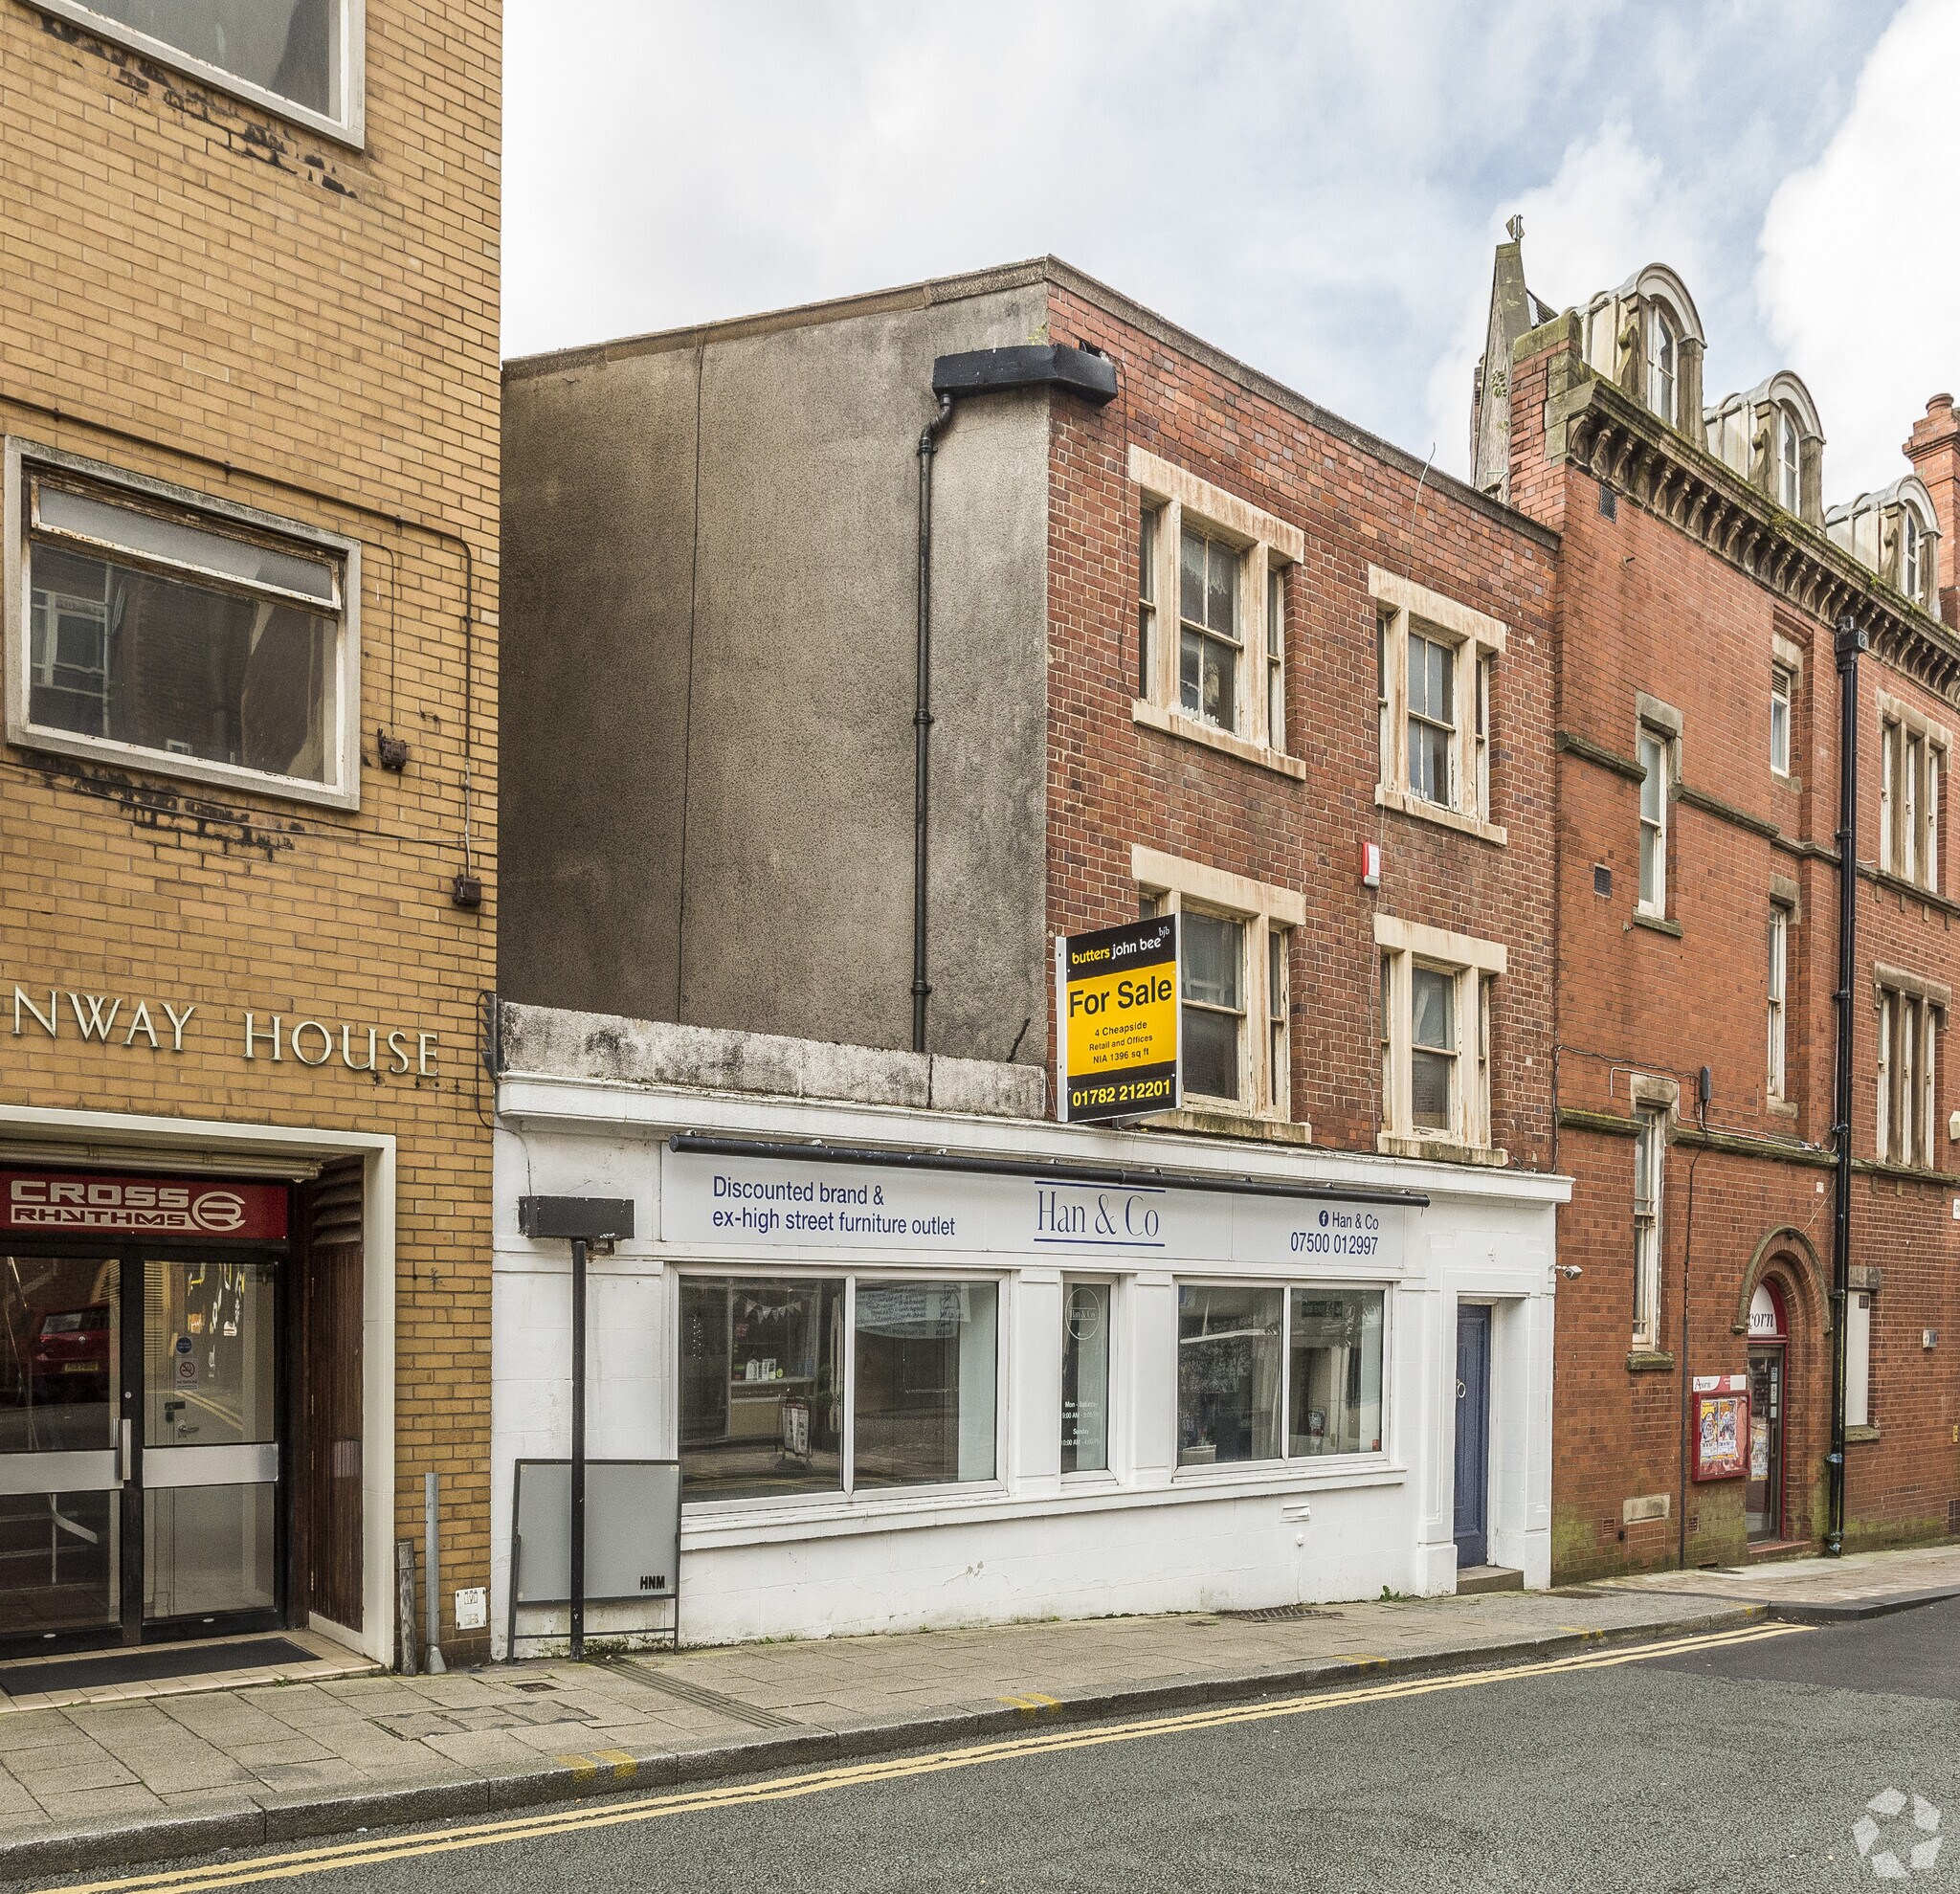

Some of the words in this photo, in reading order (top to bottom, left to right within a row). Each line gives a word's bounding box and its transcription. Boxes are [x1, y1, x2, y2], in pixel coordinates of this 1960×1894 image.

[1072, 948, 1110, 965] butters
[1112, 941, 1137, 960] john
[1140, 937, 1161, 951] bee
[1070, 989, 1109, 1018] For
[1118, 975, 1172, 1010] Sale
[11, 984, 197, 1052] NWAY
[242, 1012, 440, 1077] HOUSE
[1095, 1029, 1100, 1037] 4
[1102, 1020, 1147, 1037] Cheapside
[1089, 1040, 1110, 1052] Retail
[1112, 1038, 1125, 1049] and
[1127, 1034, 1153, 1046] Offices
[1093, 1055, 1107, 1064] NIA
[1110, 1052, 1128, 1062] 1396
[1131, 1050, 1142, 1059] sq
[1144, 1047, 1149, 1057] ft
[1073, 1087, 1115, 1107] 01782
[1120, 1079, 1170, 1100] 212201
[11, 1180, 189, 1208] CROSS
[713, 1175, 813, 1202] Discounted
[820, 1182, 868, 1205] brand
[873, 1185, 884, 1206] &
[12, 1206, 188, 1228] RHYTHMS
[712, 1207, 780, 1234] ex-high
[786, 1210, 834, 1232] street
[839, 1212, 907, 1234] furniture
[911, 1216, 956, 1236] outlet
[1037, 1191, 1086, 1233] Han
[1095, 1193, 1117, 1235] &
[1125, 1195, 1159, 1237] Co
[1332, 1212, 1352, 1229] Han
[1355, 1213, 1362, 1230] &
[1365, 1214, 1379, 1231] Co
[1290, 1232, 1329, 1253] 07500
[1334, 1235, 1378, 1256] 012997
[1749, 1312, 1773, 1329] corn
[640, 1575, 665, 1590] HNM
